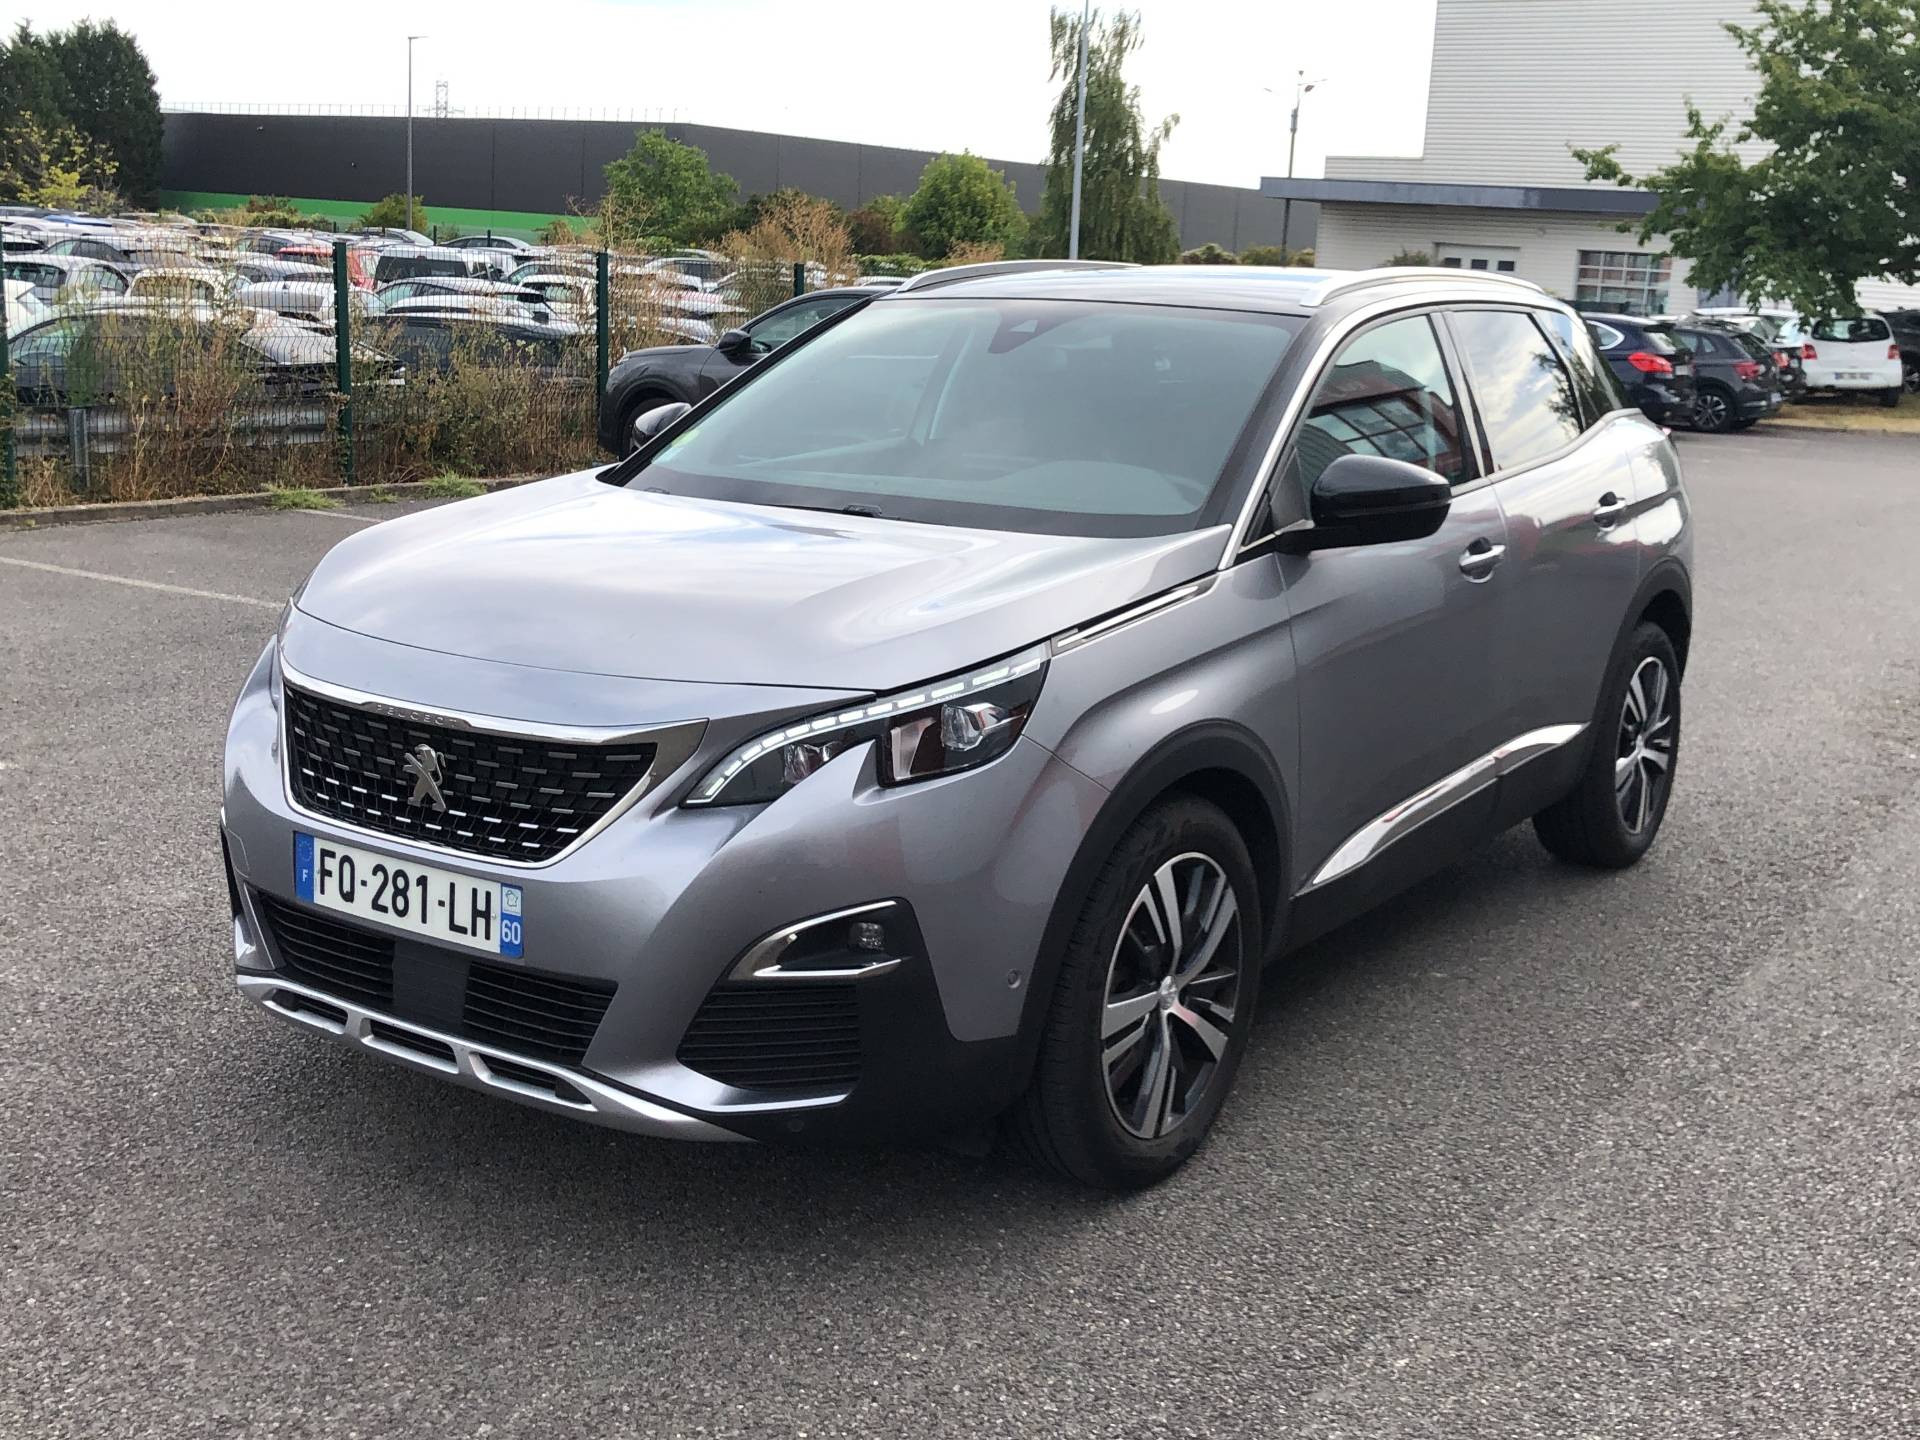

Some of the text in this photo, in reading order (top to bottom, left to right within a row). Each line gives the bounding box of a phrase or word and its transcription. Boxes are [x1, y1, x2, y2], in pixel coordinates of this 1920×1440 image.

[301, 868, 309, 882] F
[319, 848, 491, 940] FQ-281-LH
[502, 919, 521, 945] 60
